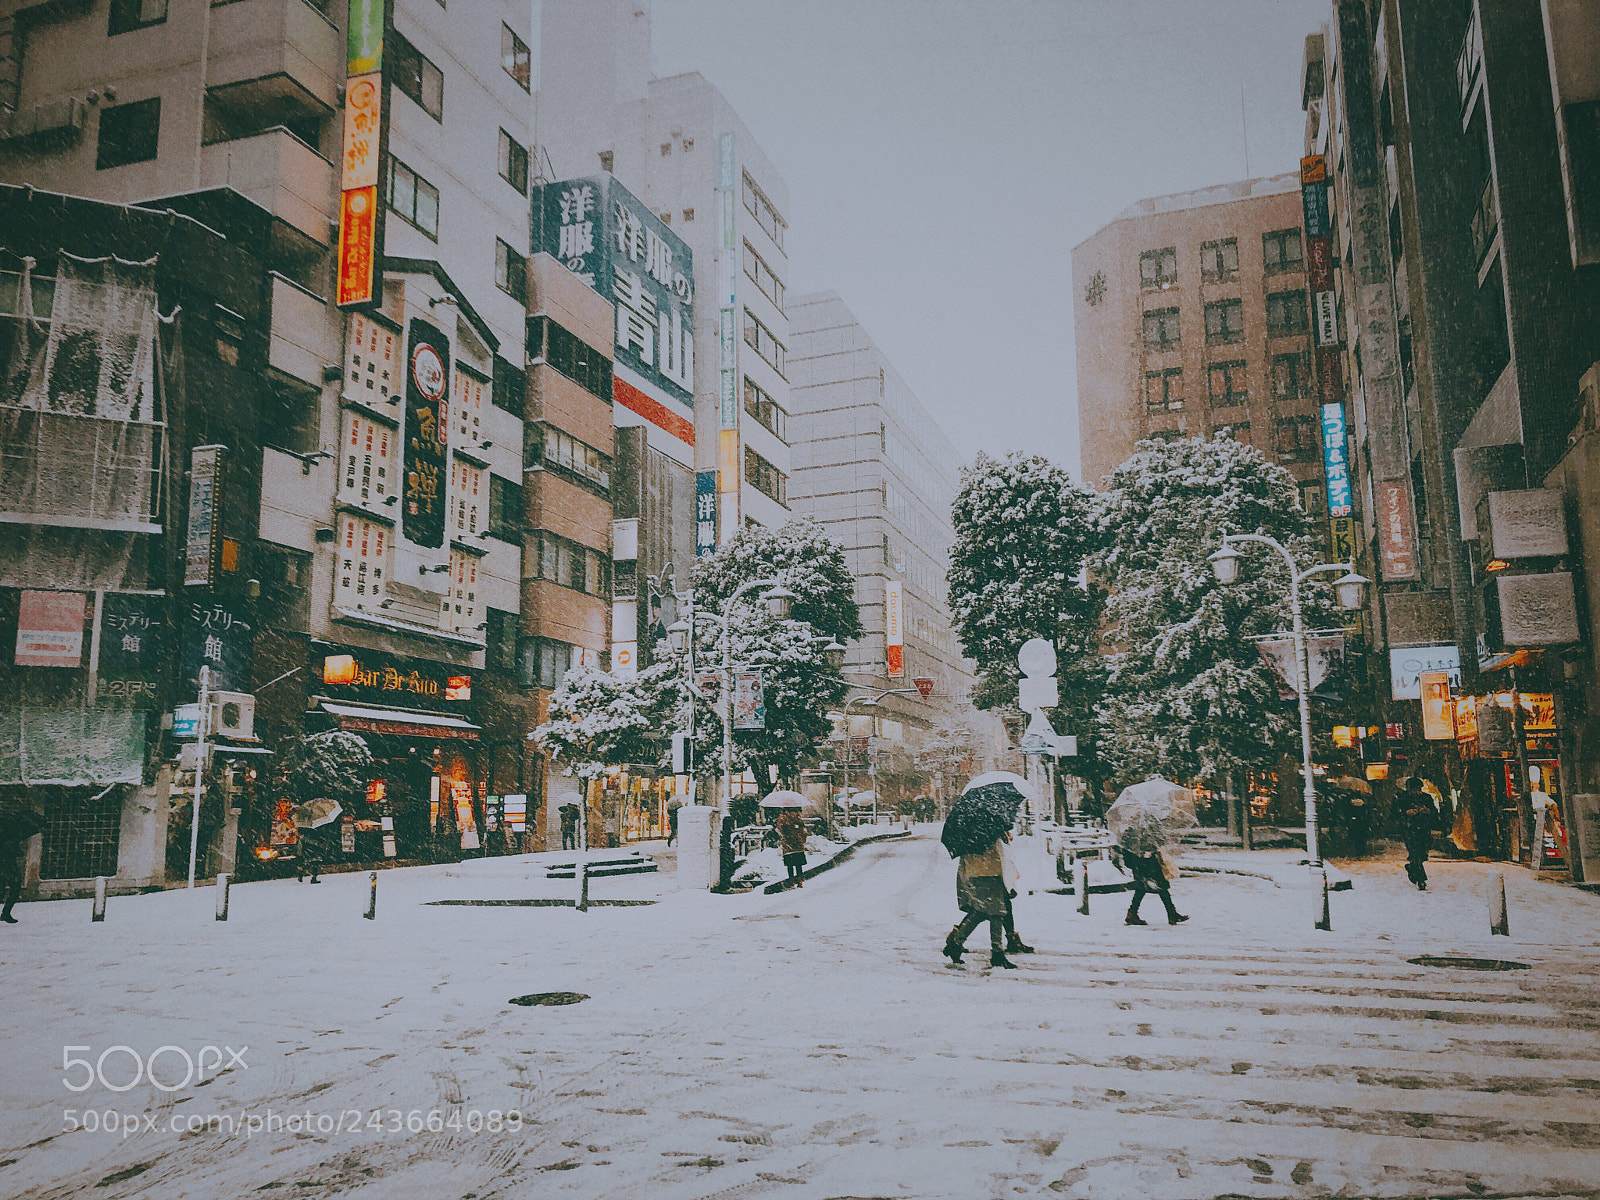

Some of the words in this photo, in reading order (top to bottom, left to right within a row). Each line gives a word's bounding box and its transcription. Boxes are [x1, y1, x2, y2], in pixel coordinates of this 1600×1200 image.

[613, 199, 693, 305] 洋服の
[612, 265, 694, 394] 青山
[1331, 505, 1351, 518] 3F
[107, 612, 161, 631] ミステリー
[191, 602, 242, 630] ミステリー
[889, 591, 899, 636] docomo
[120, 634, 141, 653] 館
[203, 634, 224, 662] 館
